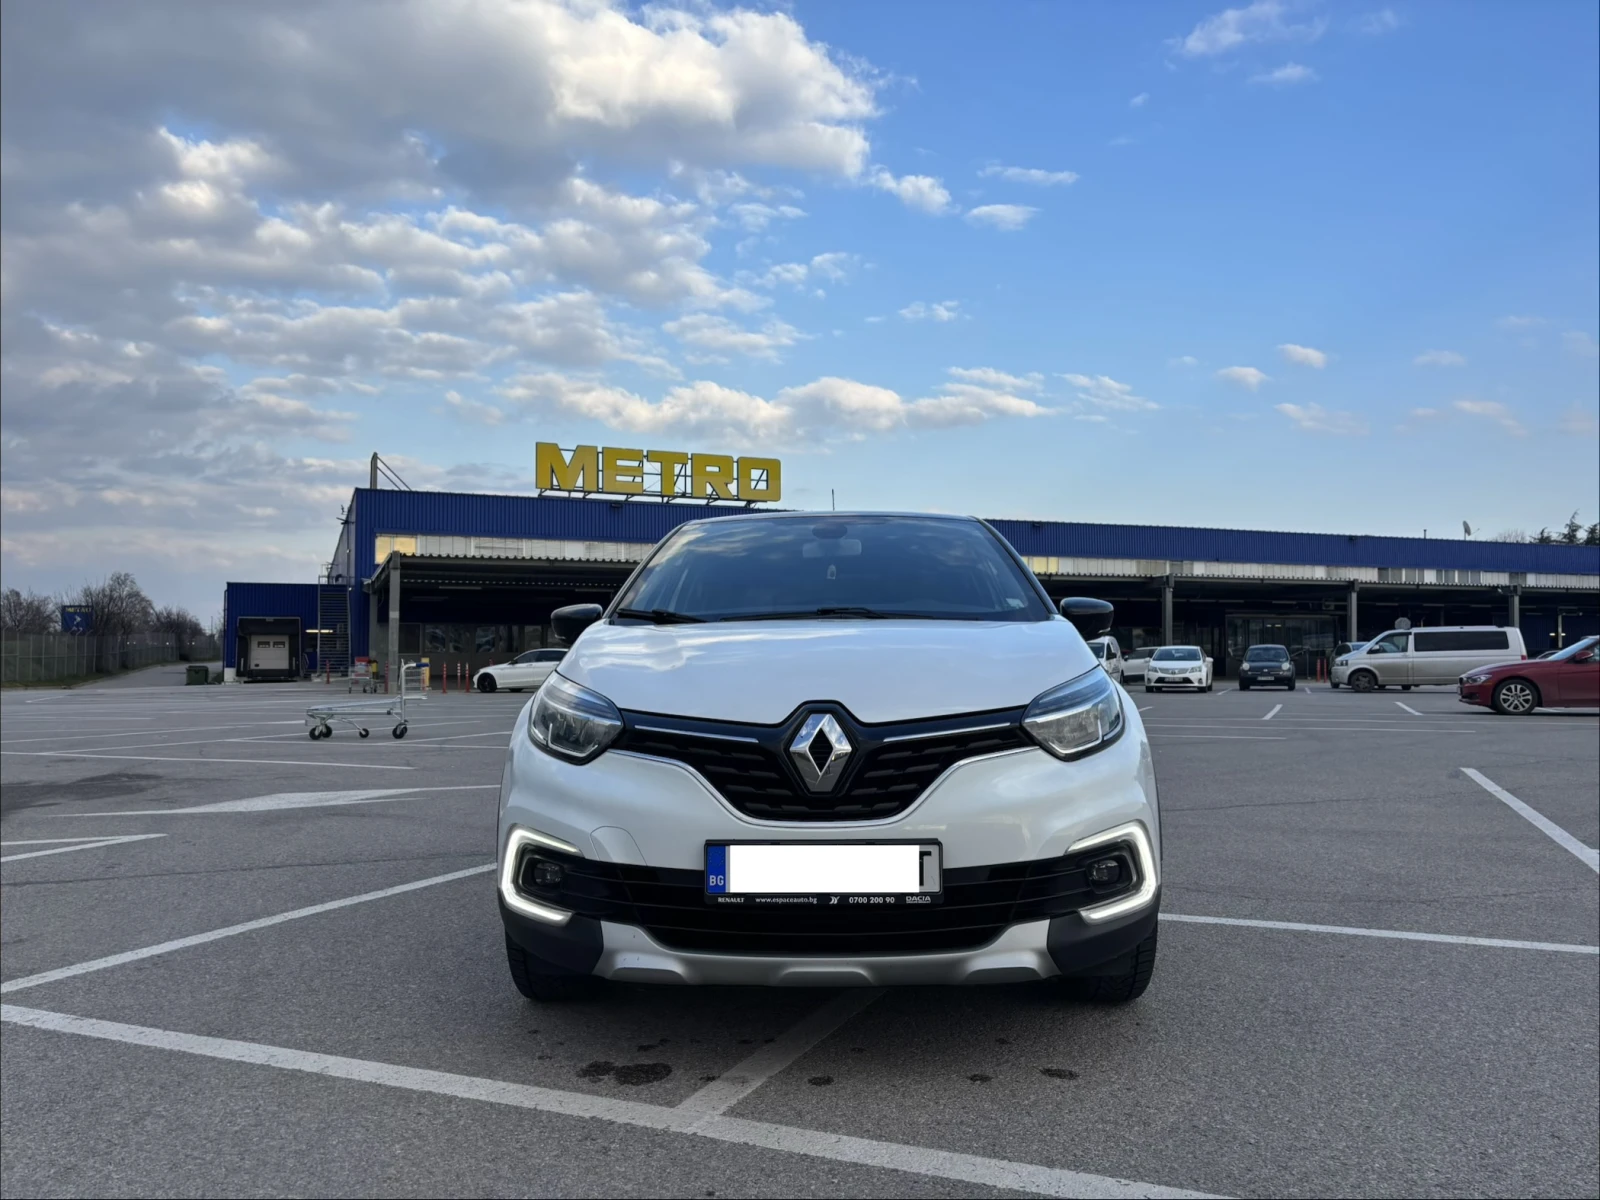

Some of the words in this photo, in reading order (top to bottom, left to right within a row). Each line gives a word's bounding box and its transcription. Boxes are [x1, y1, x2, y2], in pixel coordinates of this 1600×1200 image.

[536, 442, 781, 502] METRO
[709, 875, 724, 886] BG
[717, 896, 745, 904] RENAULT
[755, 896, 818, 905] www.espaceauto.bg
[848, 896, 868, 904] 0700
[869, 896, 884, 904] 200
[885, 896, 896, 904] 90
